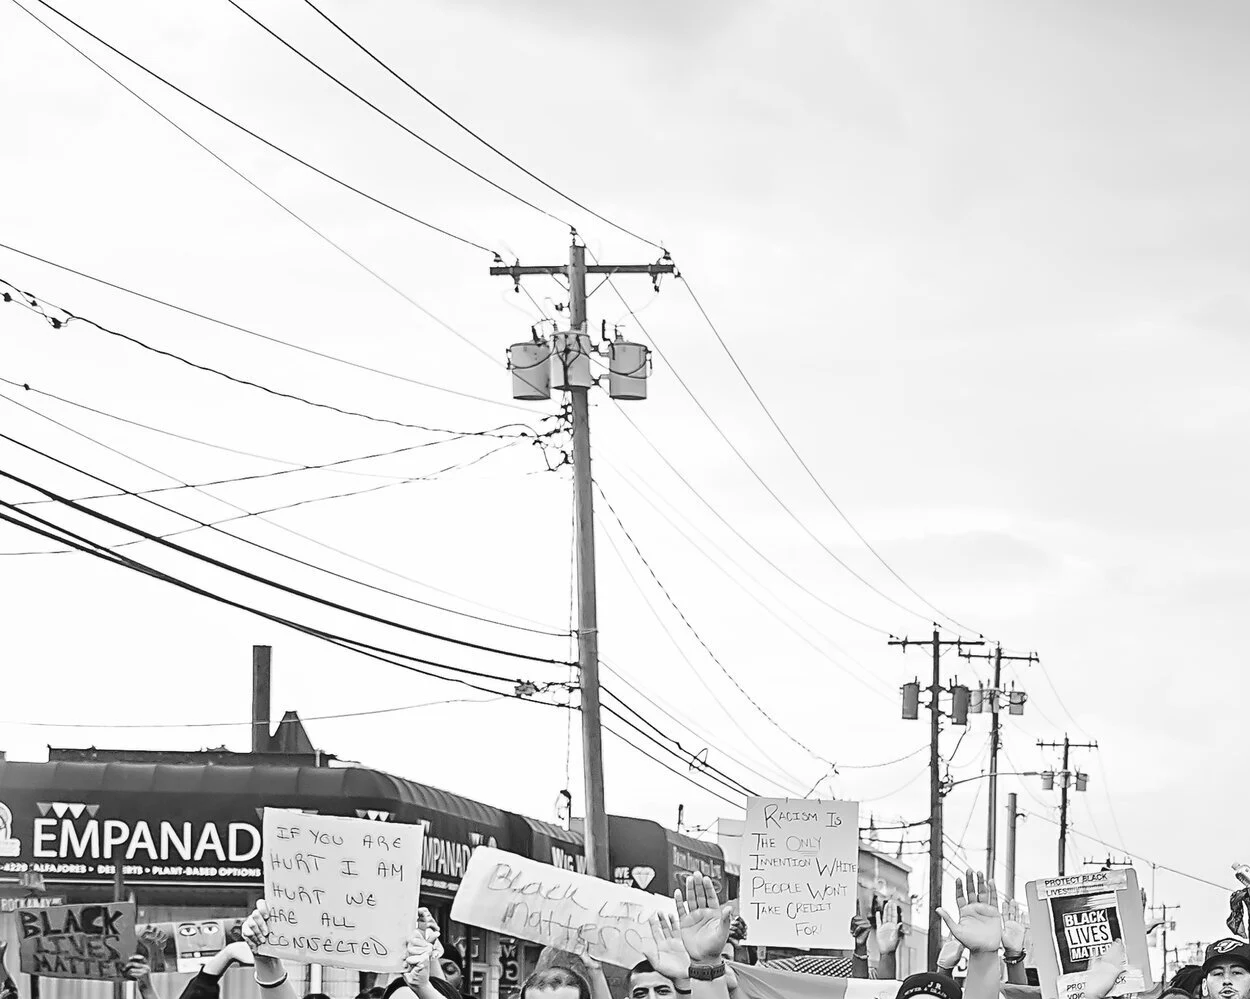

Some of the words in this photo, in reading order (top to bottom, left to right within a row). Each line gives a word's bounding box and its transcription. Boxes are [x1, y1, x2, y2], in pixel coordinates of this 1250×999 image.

[276, 826, 300, 840] IF
[309, 828, 344, 846] YOU
[363, 834, 402, 851] ARE
[270, 851, 327, 874] HURT
[340, 860, 359, 876] I
[377, 861, 404, 882] AM
[421, 835, 476, 880] MPANAD
[272, 881, 326, 905] HURT
[345, 892, 378, 907] WE
[19, 905, 123, 939] BLACK
[268, 907, 299, 925] ARE
[321, 911, 356, 929] ALL
[1065, 909, 1106, 927] BLACK
[35, 934, 121, 960] LIVES
[267, 931, 389, 957] CONNECTED
[1067, 924, 1109, 946] LIVES
[1066, 981, 1086, 992] PROT
